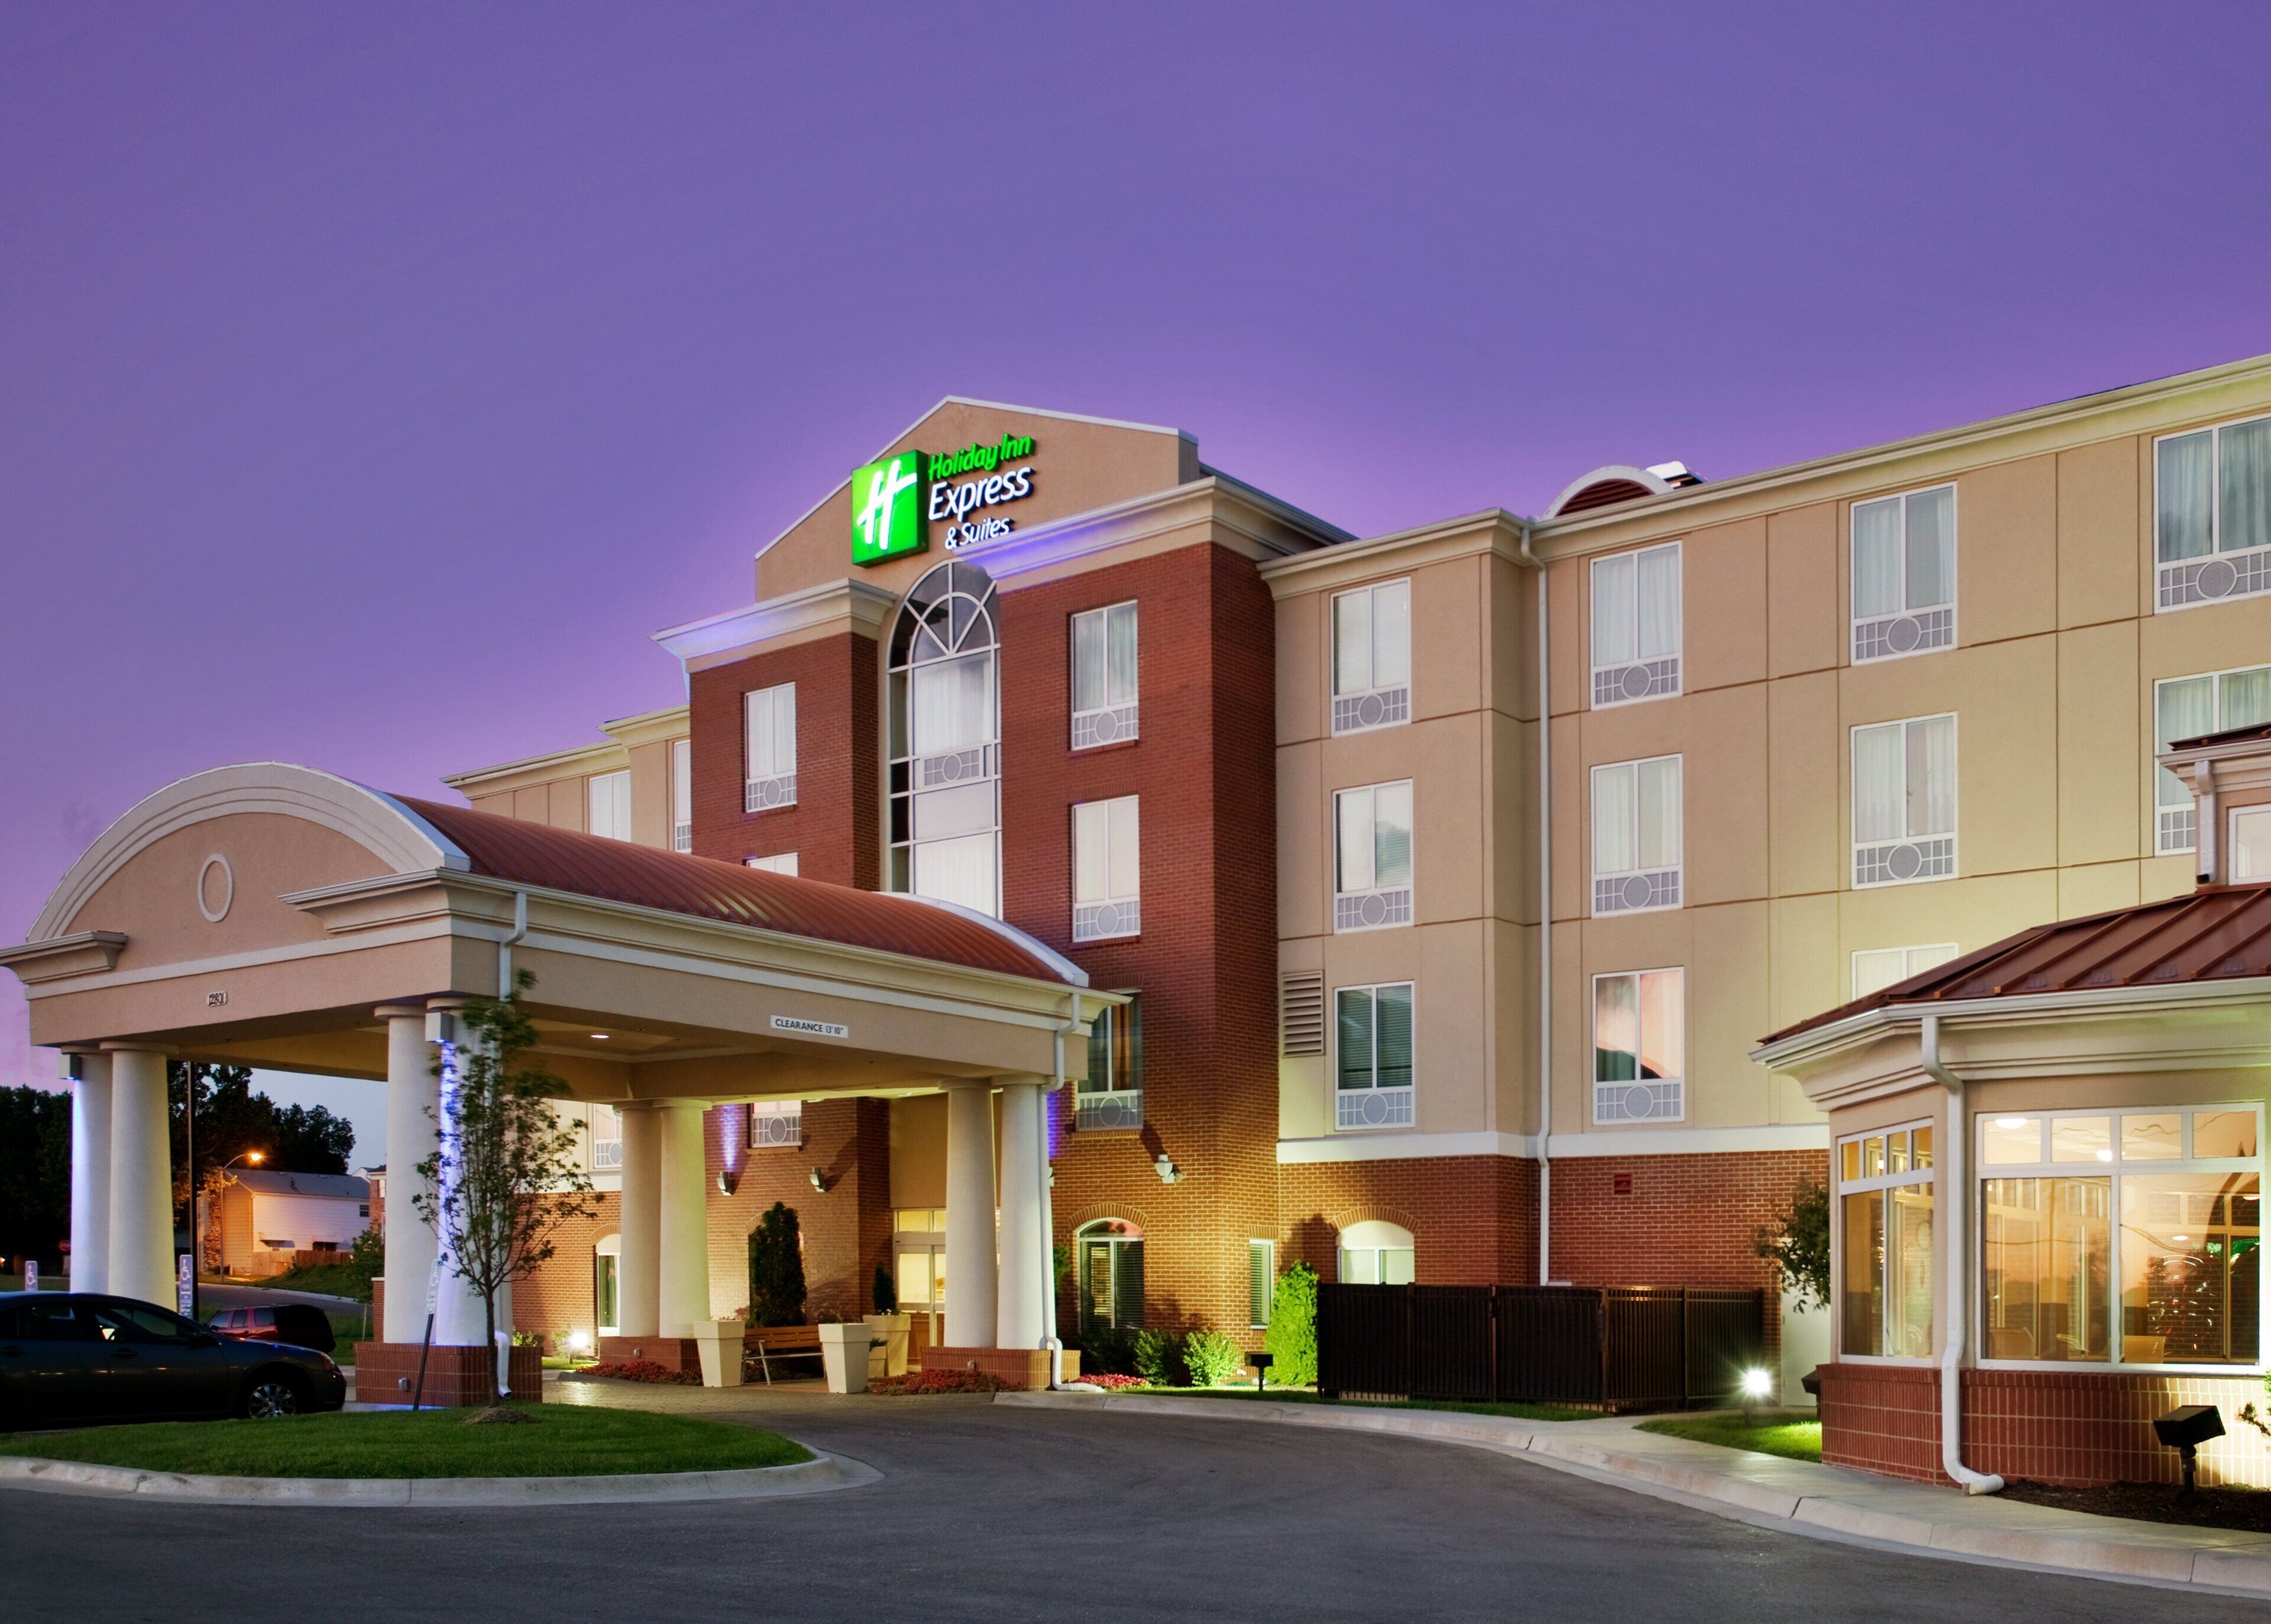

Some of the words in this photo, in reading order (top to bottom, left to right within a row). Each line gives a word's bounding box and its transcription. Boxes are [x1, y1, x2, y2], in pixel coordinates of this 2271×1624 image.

[928, 443, 999, 481] Holiday
[1001, 433, 1033, 461] Inn
[929, 467, 1032, 522] Express
[944, 526, 957, 551] &
[959, 517, 1011, 546] Suites
[775, 1018, 823, 1032] CLEARANCE
